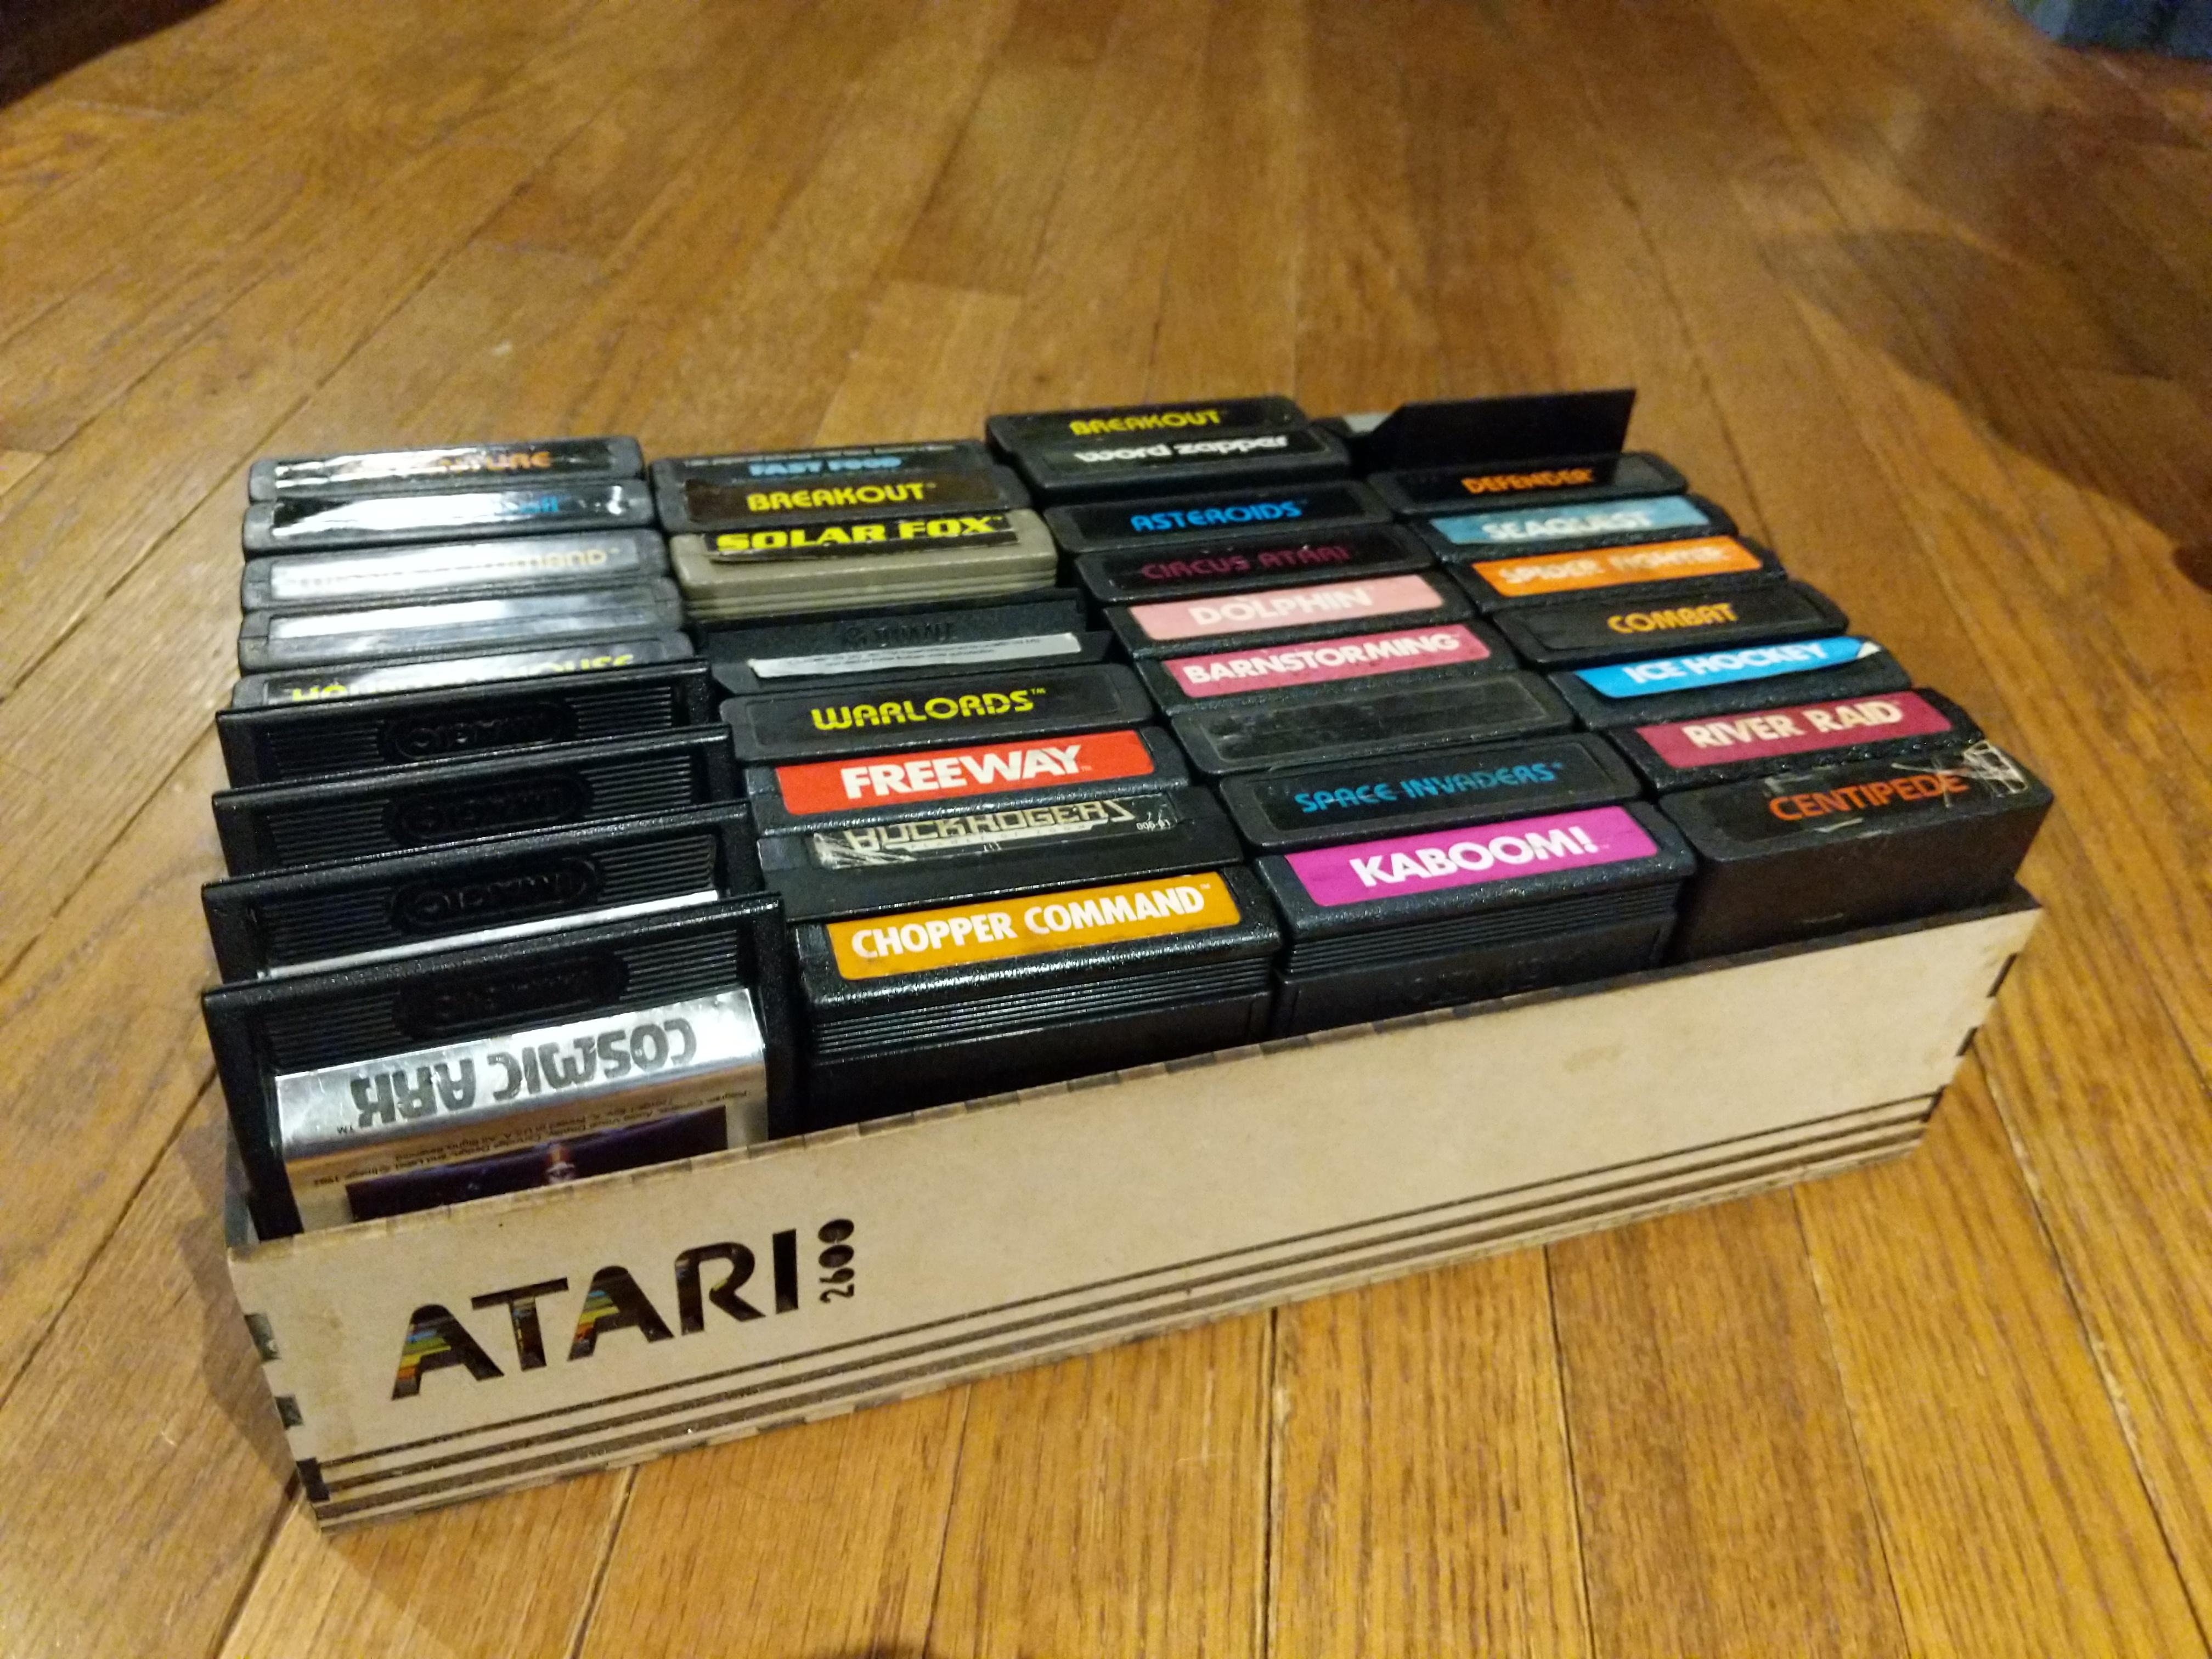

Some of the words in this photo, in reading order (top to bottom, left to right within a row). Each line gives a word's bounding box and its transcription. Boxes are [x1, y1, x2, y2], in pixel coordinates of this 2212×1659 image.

[1070, 410, 1222, 435] BREAKOUT
[749, 461, 821, 476] FAST
[827, 456, 902, 471] FOOD
[1075, 443, 1171, 461] word
[1174, 436, 1288, 455] zapper
[747, 483, 925, 511] BREAKOUT
[1461, 469, 1593, 493] DEFENDER
[716, 524, 886, 550] SOLAR
[899, 516, 997, 539] FOX
[1131, 500, 1302, 532] ASTEROIDS
[1482, 510, 1651, 539] SEAQUEST
[1141, 555, 1251, 579] CIRCUS
[1261, 547, 1350, 569] ATARI
[1498, 558, 1603, 584] SPIDER
[1608, 546, 1730, 571] FIGHTER
[1188, 587, 1372, 626] DOLPHIN
[1607, 603, 1737, 633] COMBAT
[1183, 633, 1458, 683] BARNSTORMING
[1622, 659, 1687, 684] ICE
[1691, 644, 1827, 675] HOCKEY
[811, 690, 1034, 731] WARLORDS
[1682, 715, 1802, 748] RIVER
[1802, 701, 1903, 734] RAID
[840, 745, 1082, 799] FREEWAY
[1295, 783, 1397, 814] SPACE
[1401, 763, 1555, 799] INVADERS
[1769, 773, 1971, 821] CENTIPEDE
[1350, 826, 1598, 888] KABOOM!
[852, 912, 1018, 958] CHOPPER
[1023, 885, 1205, 934] COMMAND
[487, 1018, 697, 1101] COSMIC
[351, 1058, 478, 1128] ARK
[391, 1228, 799, 1401] ATARI
